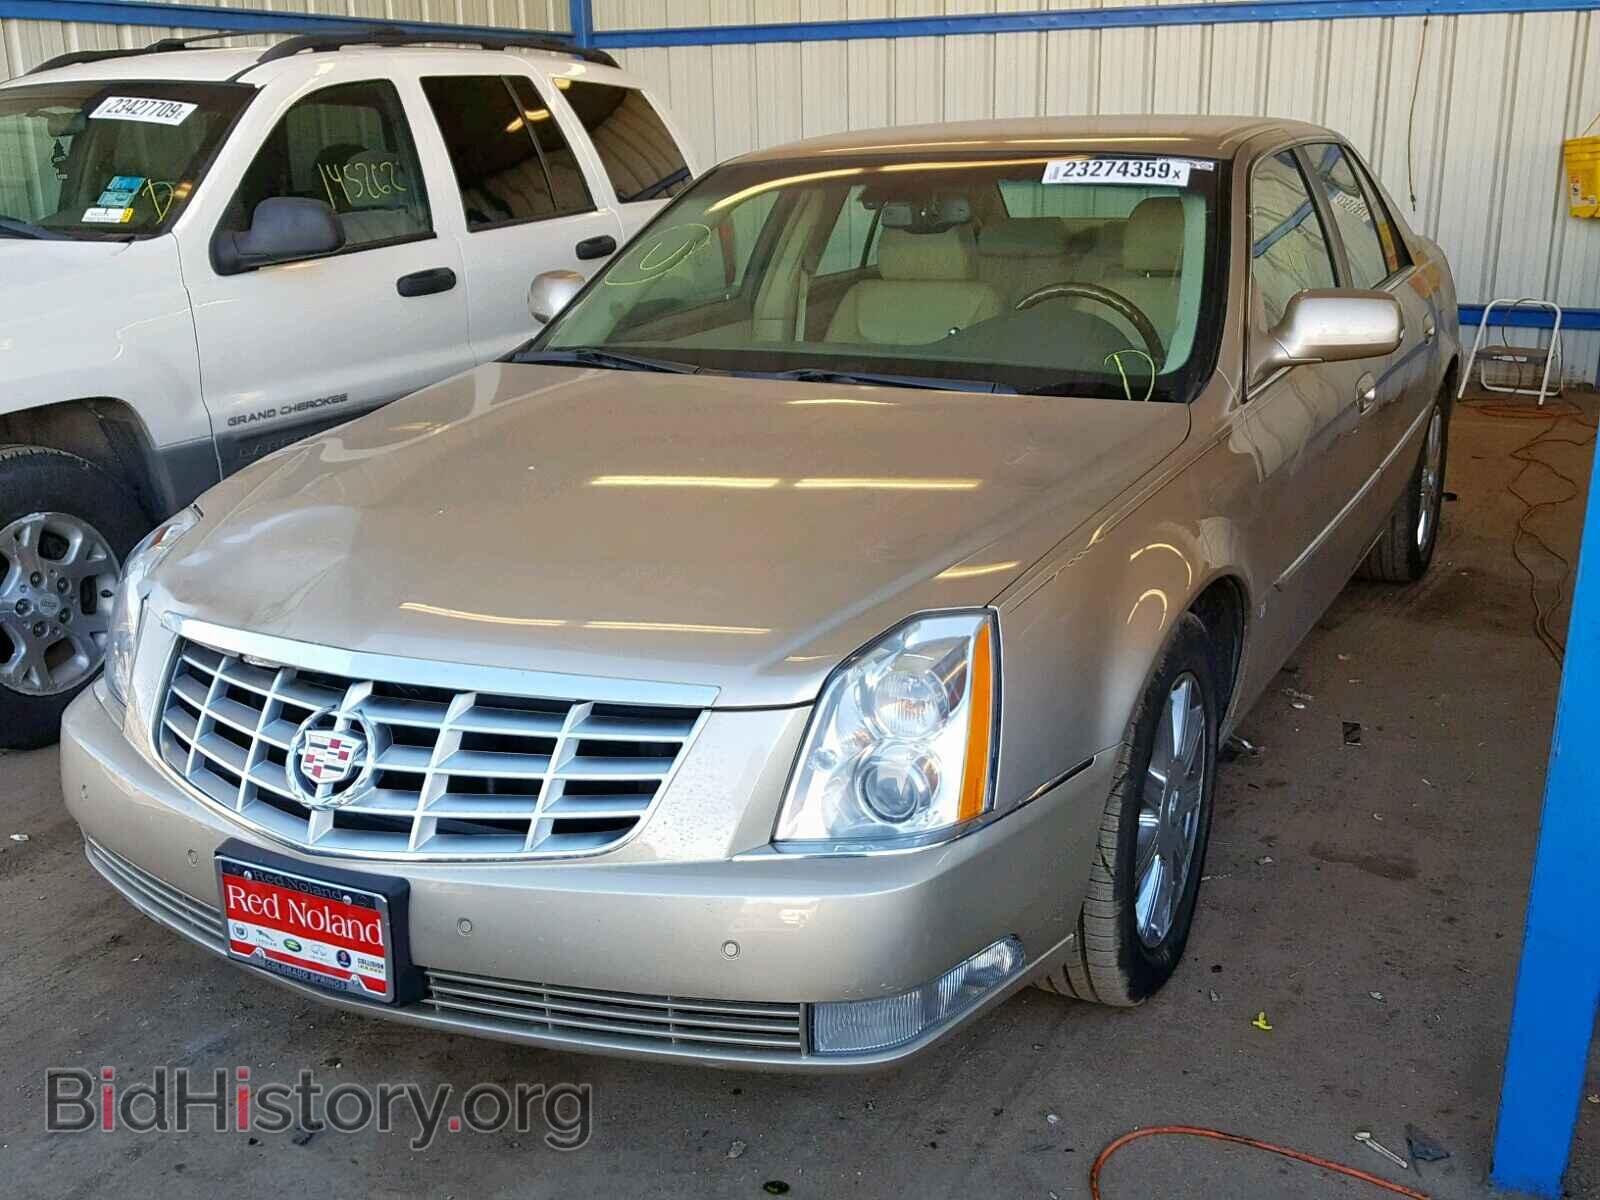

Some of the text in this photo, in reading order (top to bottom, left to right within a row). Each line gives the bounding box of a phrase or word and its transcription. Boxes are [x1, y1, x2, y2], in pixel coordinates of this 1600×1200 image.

[317, 161, 407, 209] 145262
[227, 392, 349, 427] GRAND CHEROKEE
[253, 870, 342, 900] Red Noland
[226, 884, 385, 946] Red Noland
